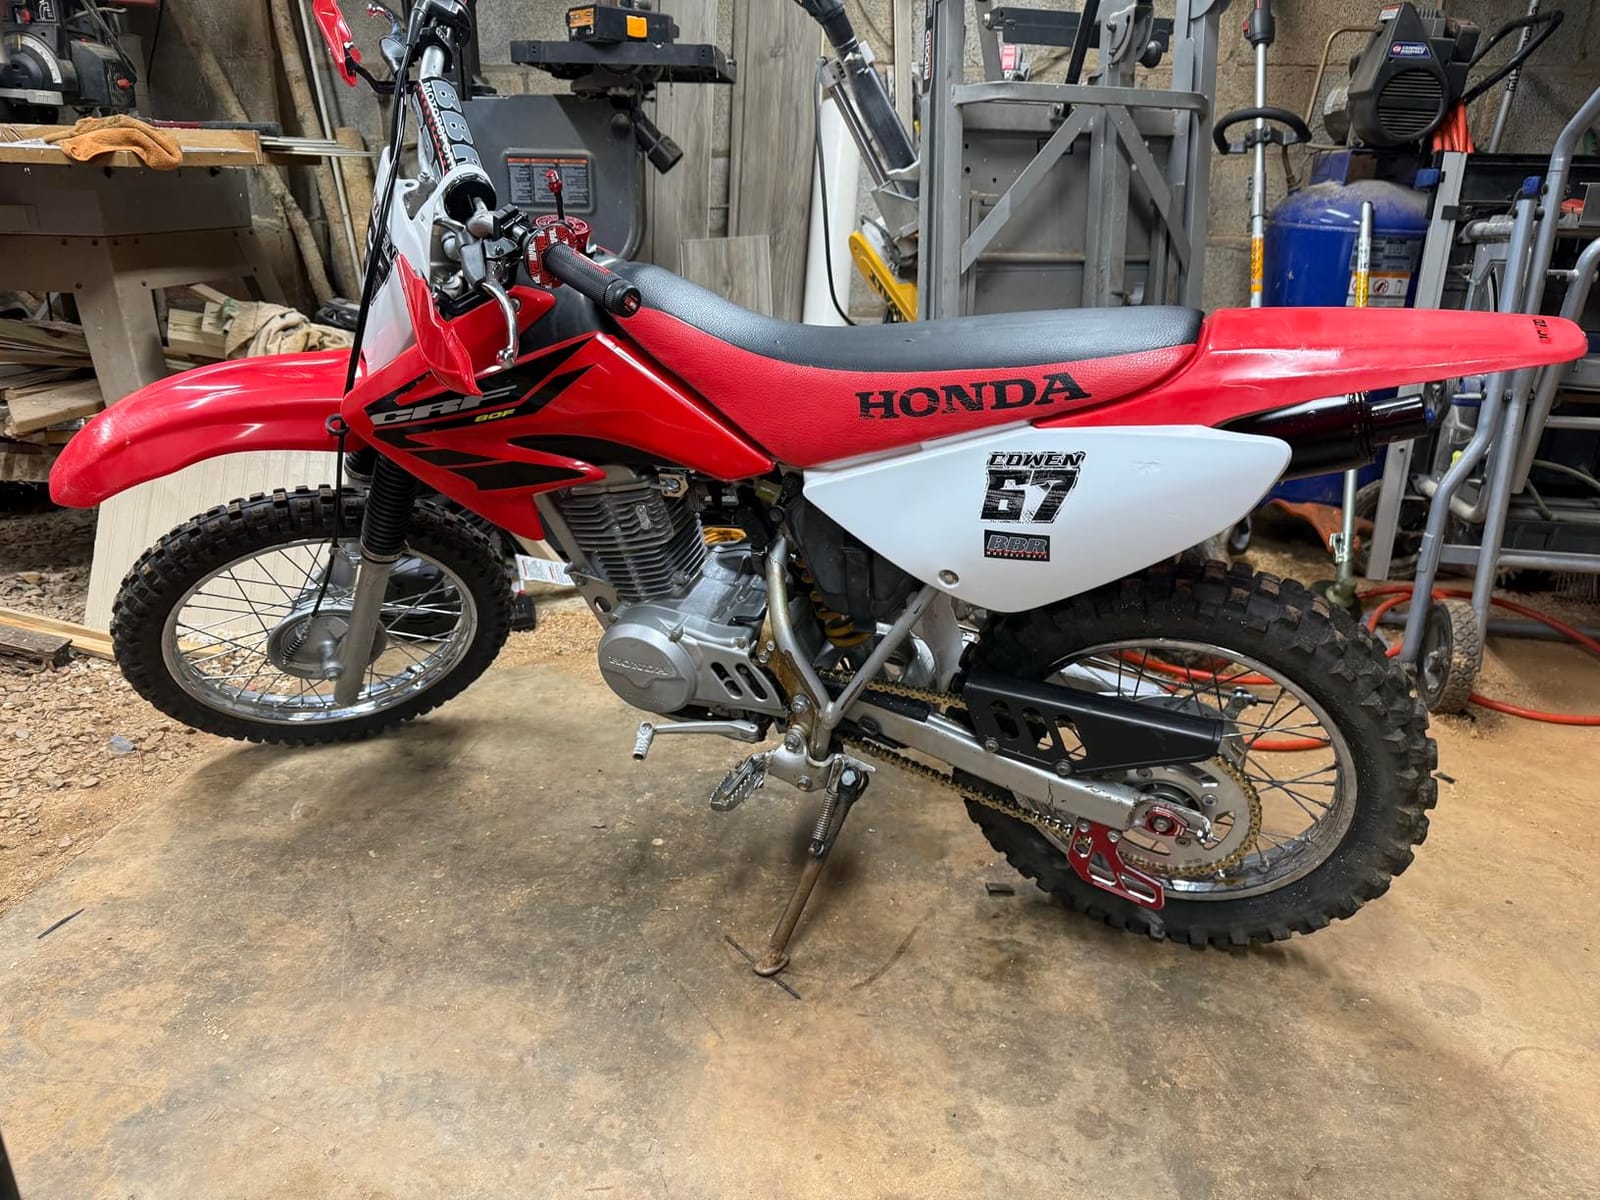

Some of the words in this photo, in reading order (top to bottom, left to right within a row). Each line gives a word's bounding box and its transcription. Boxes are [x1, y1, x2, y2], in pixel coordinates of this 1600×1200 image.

[923, 30, 932, 81] RIDGID
[369, 384, 518, 426] CRF
[855, 372, 1092, 420] HONDA
[474, 408, 517, 423] 80F
[987, 452, 1085, 468] COWEN
[980, 468, 1080, 522] 67
[987, 534, 1048, 553] BBR
[607, 655, 669, 677] HONDA
